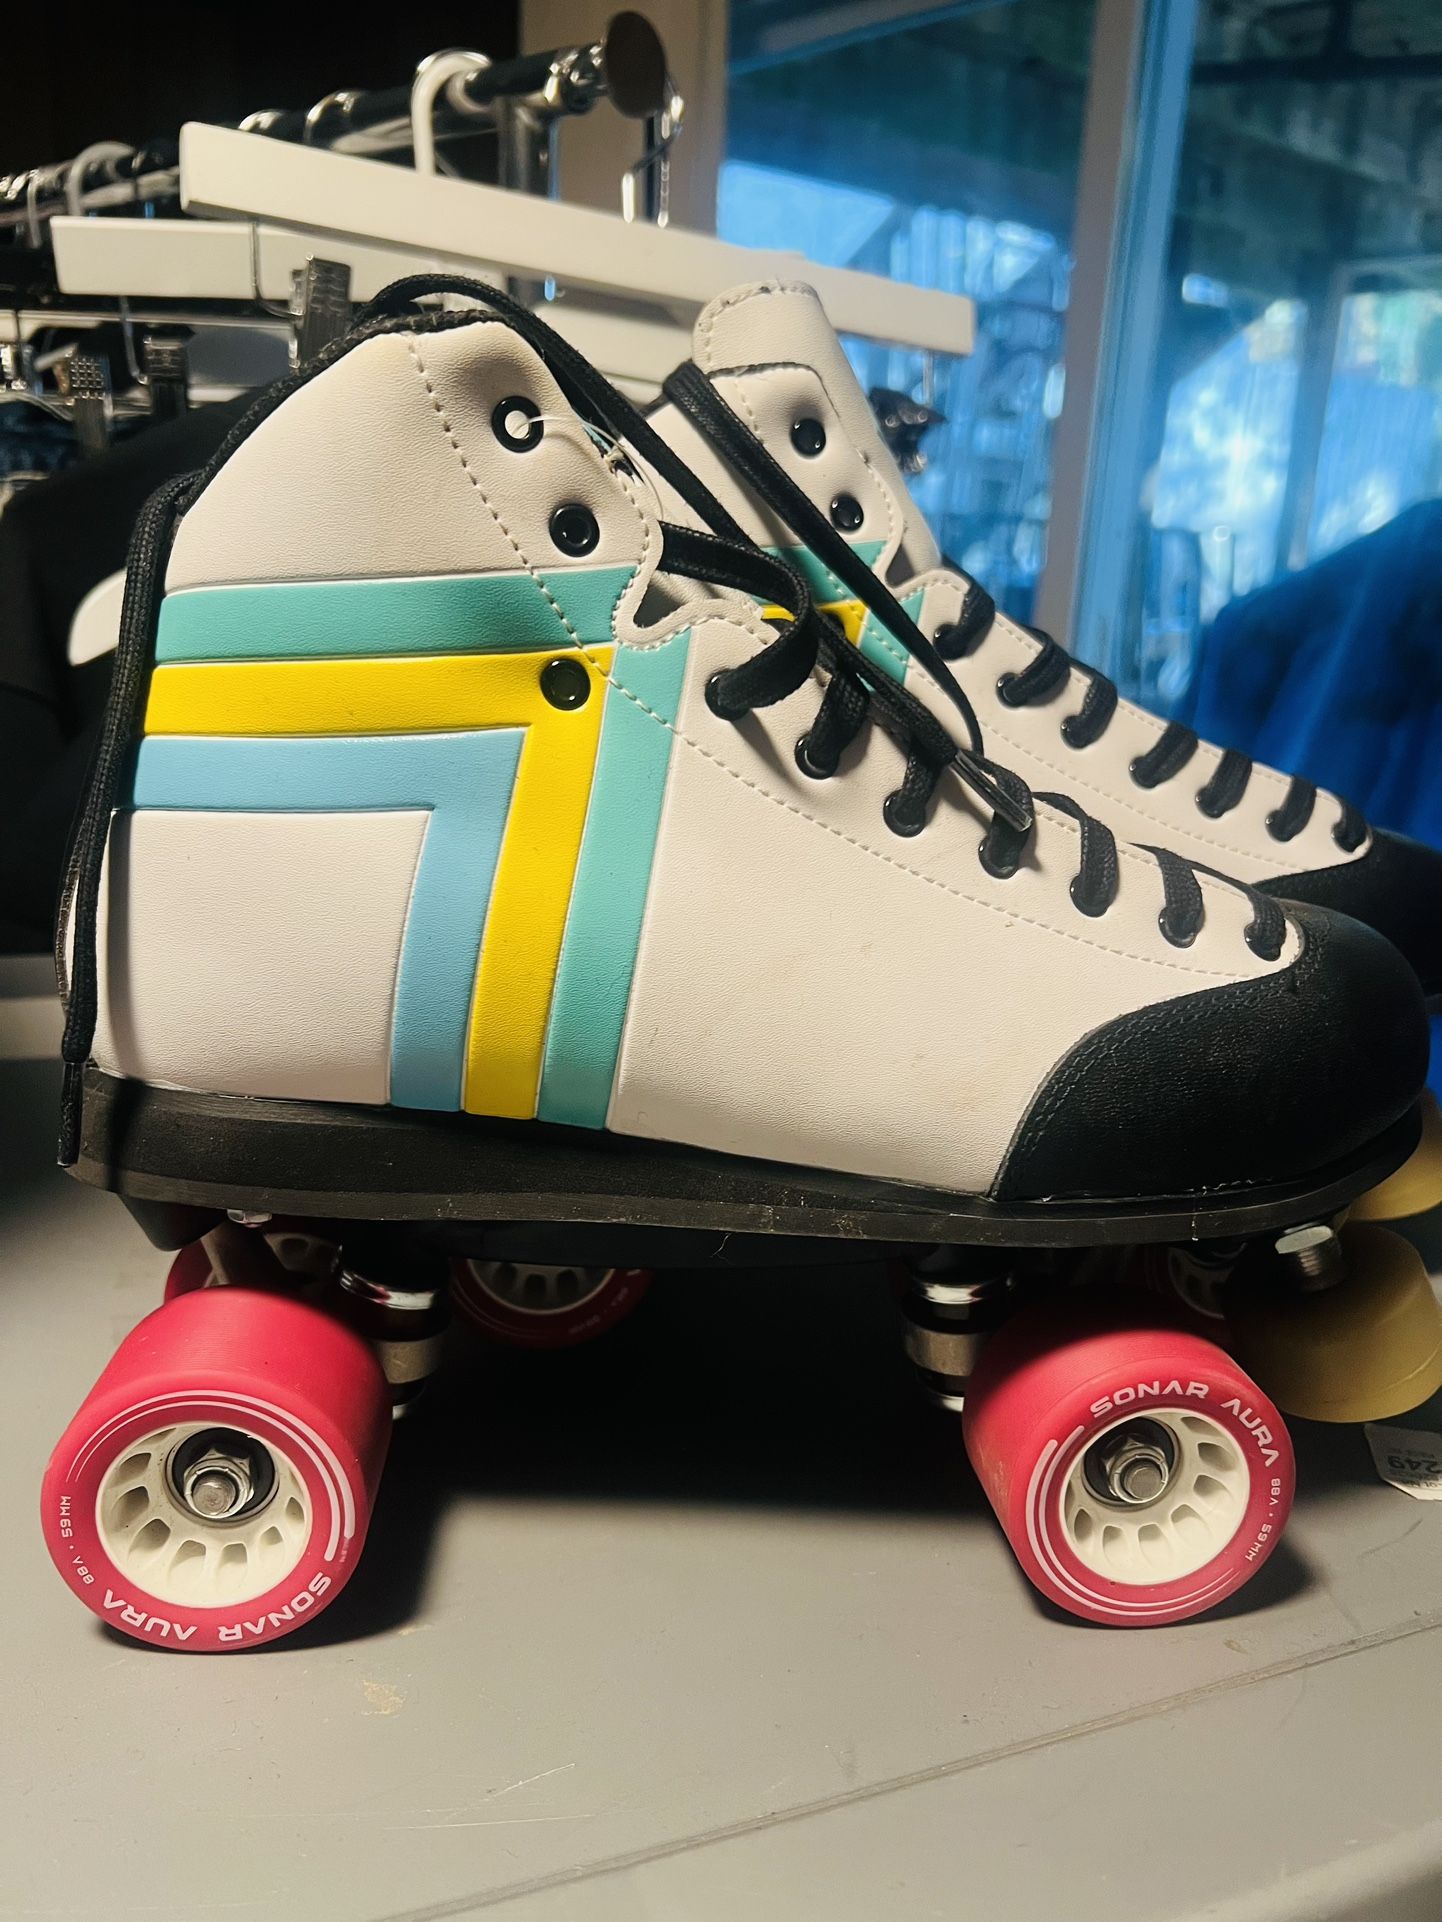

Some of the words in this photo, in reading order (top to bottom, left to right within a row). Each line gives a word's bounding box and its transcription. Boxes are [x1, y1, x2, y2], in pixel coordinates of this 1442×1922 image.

[1090, 1380, 1210, 1419] SONAR
[1220, 1398, 1280, 1467] AURA
[103, 1589, 198, 1641] AURA
[218, 1572, 332, 1642] SONAR
